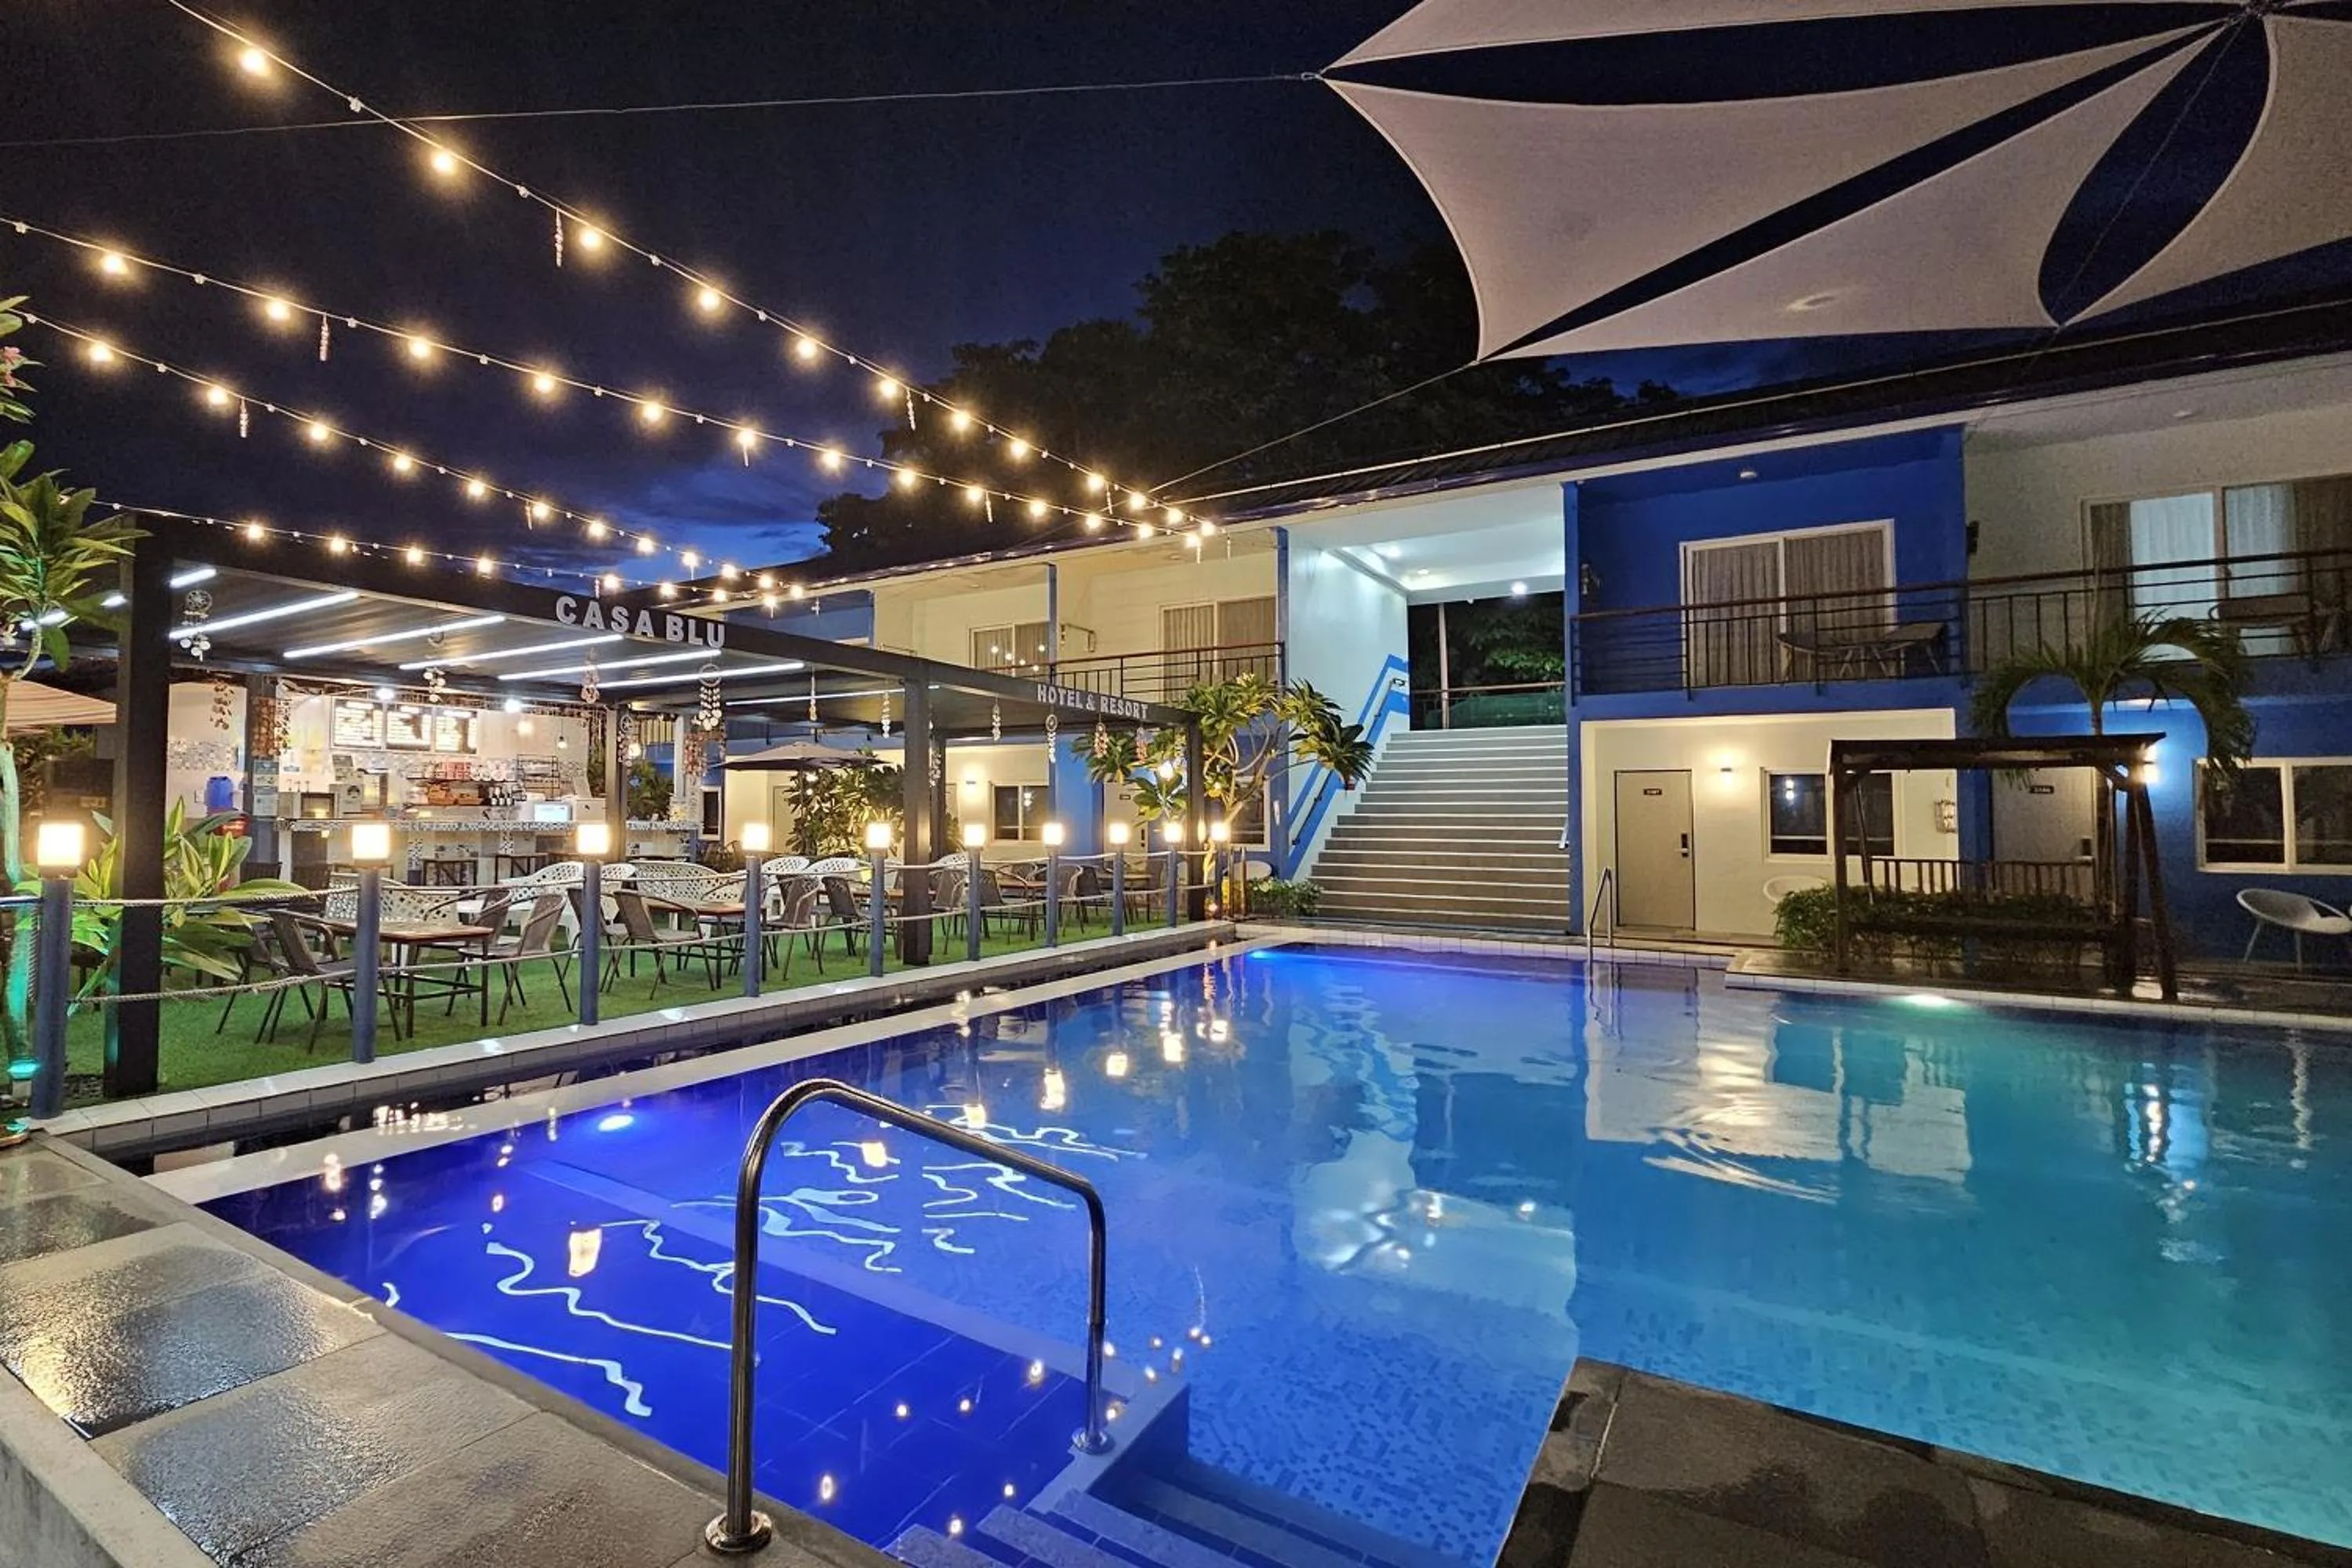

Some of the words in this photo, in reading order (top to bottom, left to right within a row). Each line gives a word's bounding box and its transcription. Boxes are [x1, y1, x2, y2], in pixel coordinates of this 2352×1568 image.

[556, 596, 654, 638] CASA
[666, 615, 725, 648] BLU
[1037, 684, 1083, 710] HOTEL
[1086, 694, 1096, 711] &
[1100, 696, 1149, 719] RESORT
